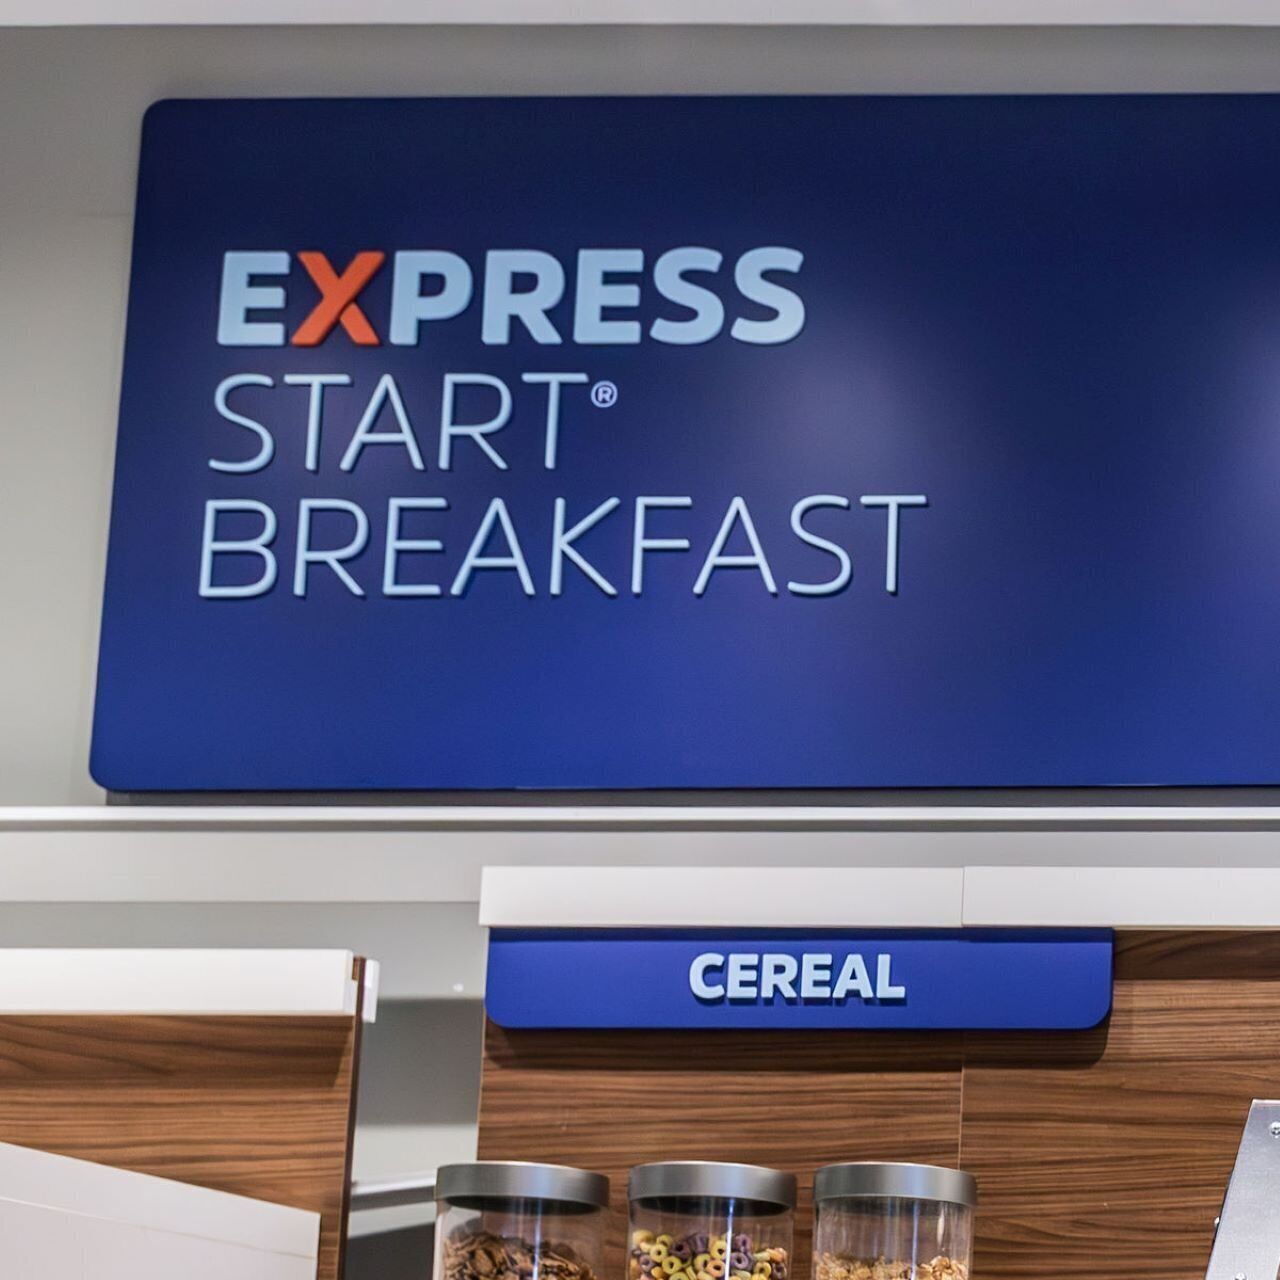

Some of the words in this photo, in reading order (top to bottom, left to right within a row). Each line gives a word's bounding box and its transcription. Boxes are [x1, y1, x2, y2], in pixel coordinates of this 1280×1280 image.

[216, 246, 806, 346] EXPRESS
[198, 494, 929, 599] BREAKFAST
[688, 952, 907, 1002] CEREAL
